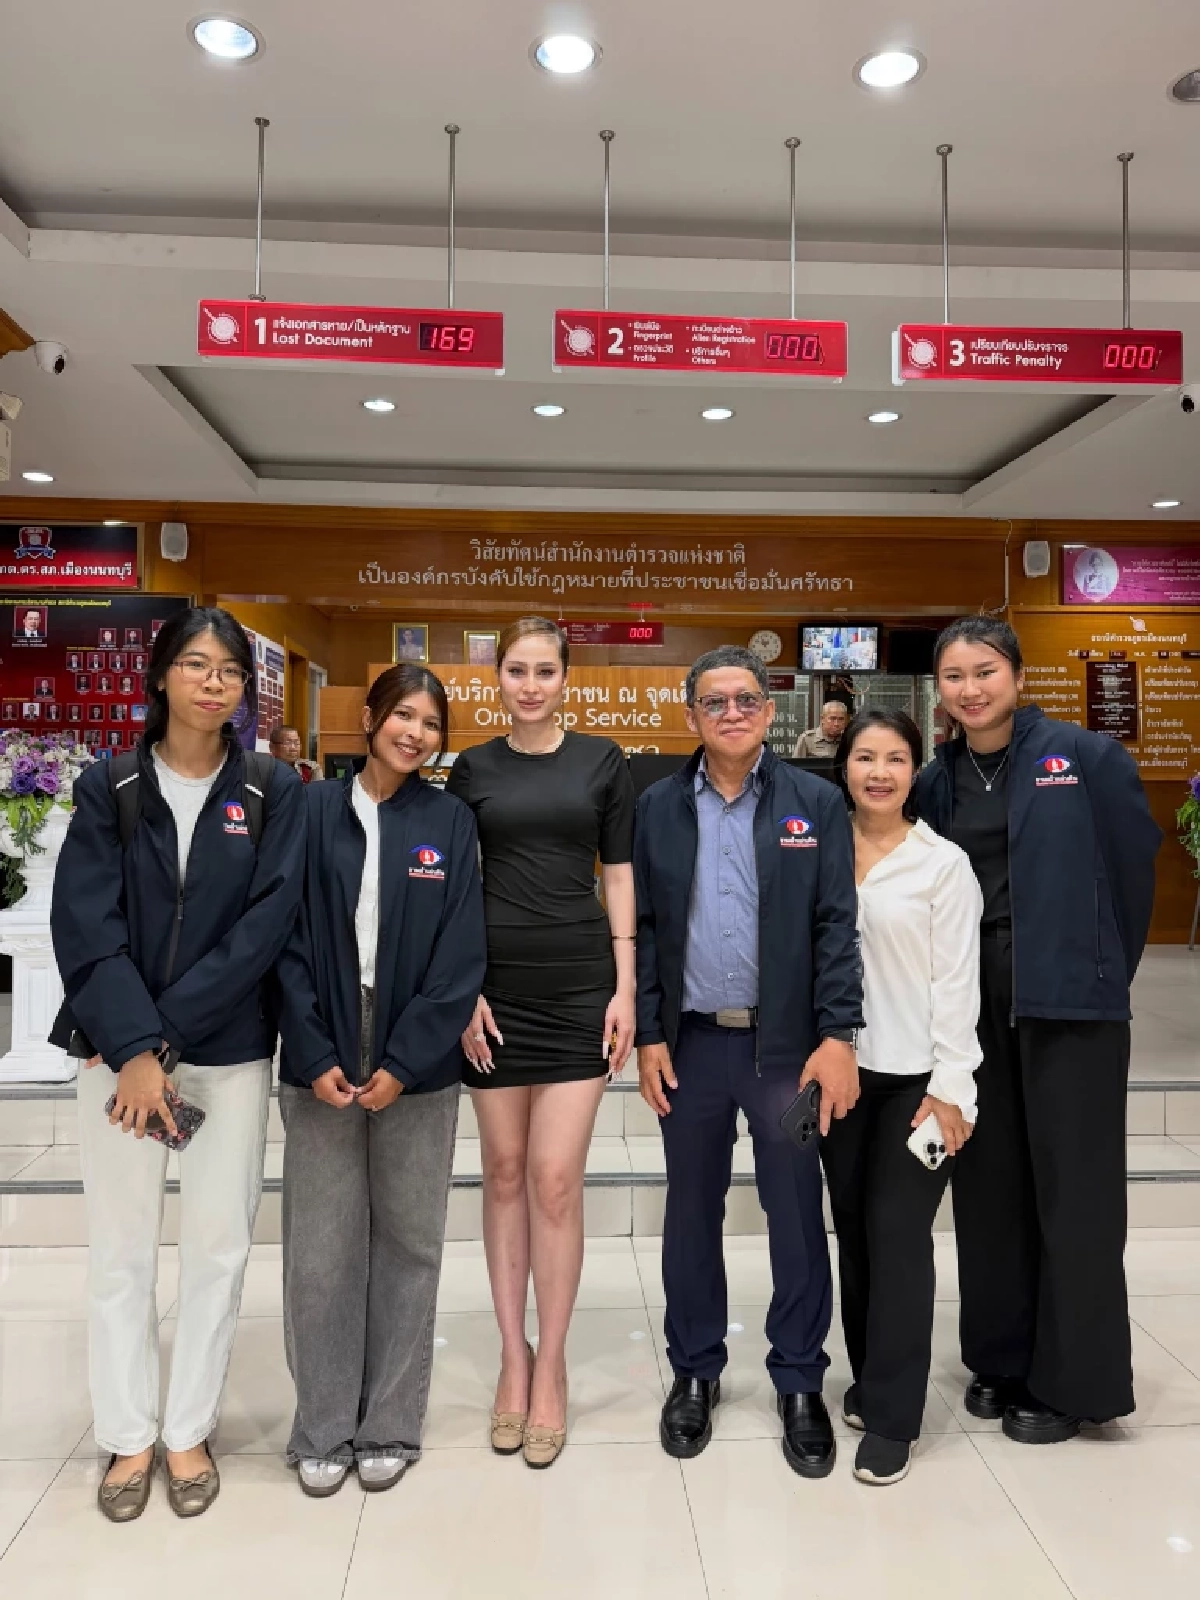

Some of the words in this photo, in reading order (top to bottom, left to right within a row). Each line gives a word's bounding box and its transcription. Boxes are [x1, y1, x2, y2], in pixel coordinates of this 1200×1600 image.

[254, 316, 267, 345] 1
[272, 332, 300, 345] Lost
[305, 333, 373, 348] Document
[430, 327, 475, 351] 169
[607, 327, 624, 354] 2
[633, 331, 673, 341] Fingerprint
[633, 354, 656, 363] Profile
[767, 335, 819, 359] 000
[949, 340, 965, 366] 3
[1105, 344, 1155, 368] 000
[970, 353, 1010, 366] Traffic
[1015, 354, 1062, 370] Penalty
[469, 538, 746, 565] วิสัยทัศน์สำนักงานตำรวจแห่งชาติ
[357, 561, 854, 594] เป็นองค์กรบังคับใช้กฎหมายที่ประชาชนเชื่อมั่นศรัทธา
[629, 627, 653, 638] 000
[619, 686, 637, 704] ณ
[585, 708, 662, 726] Service
